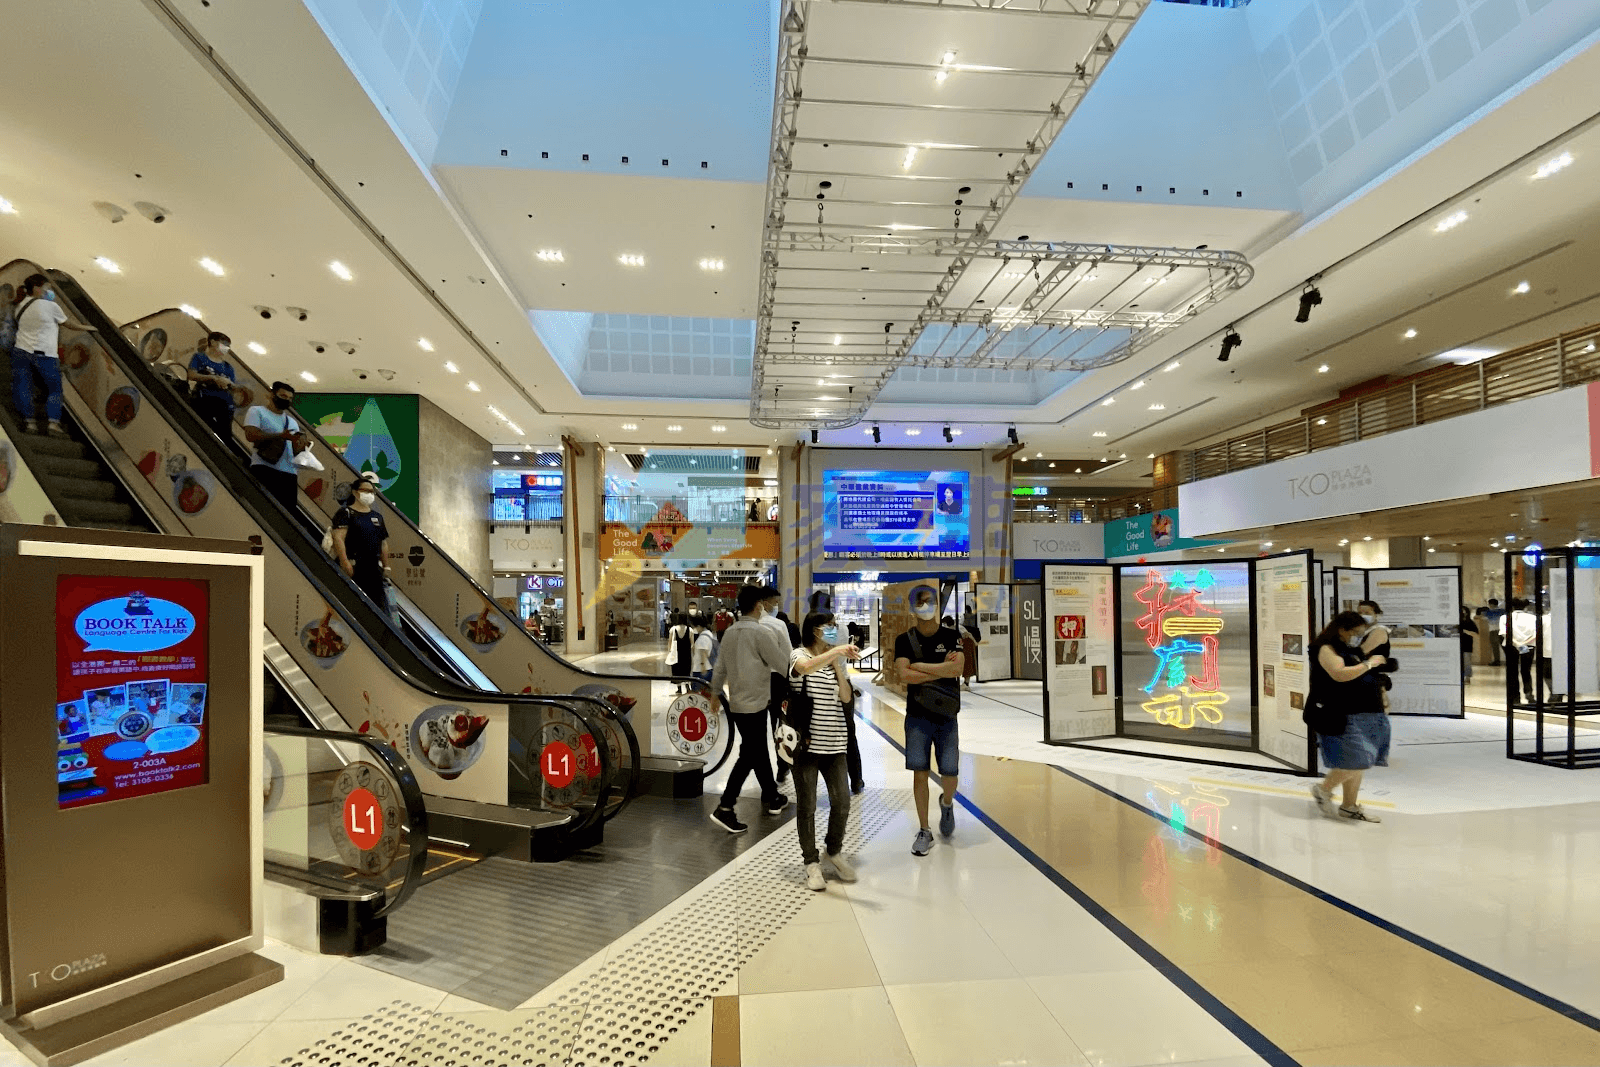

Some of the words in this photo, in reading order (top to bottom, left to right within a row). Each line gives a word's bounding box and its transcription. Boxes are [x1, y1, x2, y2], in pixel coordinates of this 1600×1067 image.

[1288, 473, 1330, 499] TKO
[1331, 465, 1372, 482] PLAZA
[1126, 521, 1139, 530] The
[613, 530, 630, 538] The
[1126, 531, 1145, 541] Good
[503, 539, 530, 551] TKO
[613, 539, 638, 547] Good
[1033, 539, 1058, 552] TKO
[1126, 542, 1139, 552] Life
[613, 548, 630, 556] Life
[84, 618, 137, 630] BOOK
[140, 617, 188, 629] TALK
[1062, 617, 1077, 638] 押
[1023, 626, 1041, 664] 慢
[684, 716, 702, 734] L1
[132, 757, 167, 769] 2-003A
[547, 753, 569, 776] L1
[114, 762, 201, 781] www.booktalk2.com
[350, 803, 375, 835] L1
